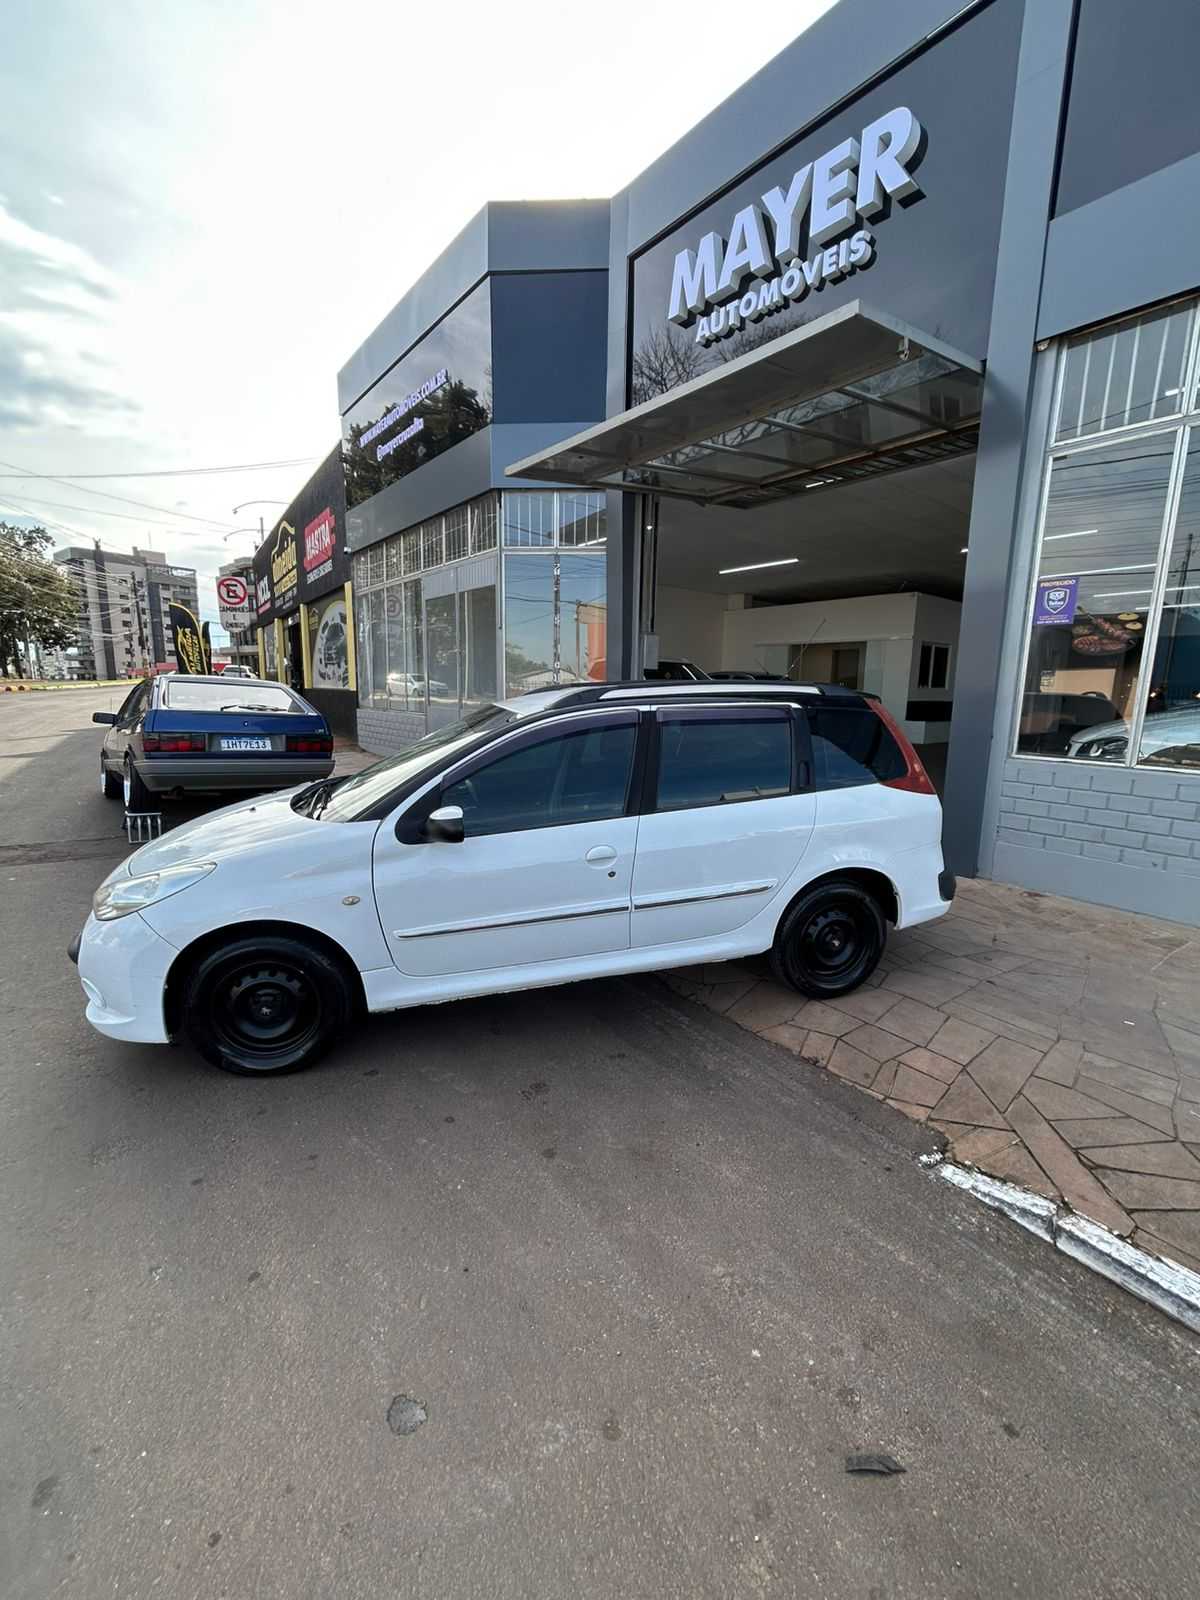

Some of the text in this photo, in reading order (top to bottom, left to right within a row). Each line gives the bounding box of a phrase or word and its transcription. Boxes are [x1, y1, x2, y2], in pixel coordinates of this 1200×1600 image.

[668, 106, 922, 323] MAYER
[695, 230, 874, 346] AUTOMÓVEIS
[305, 519, 331, 560] MASTRA
